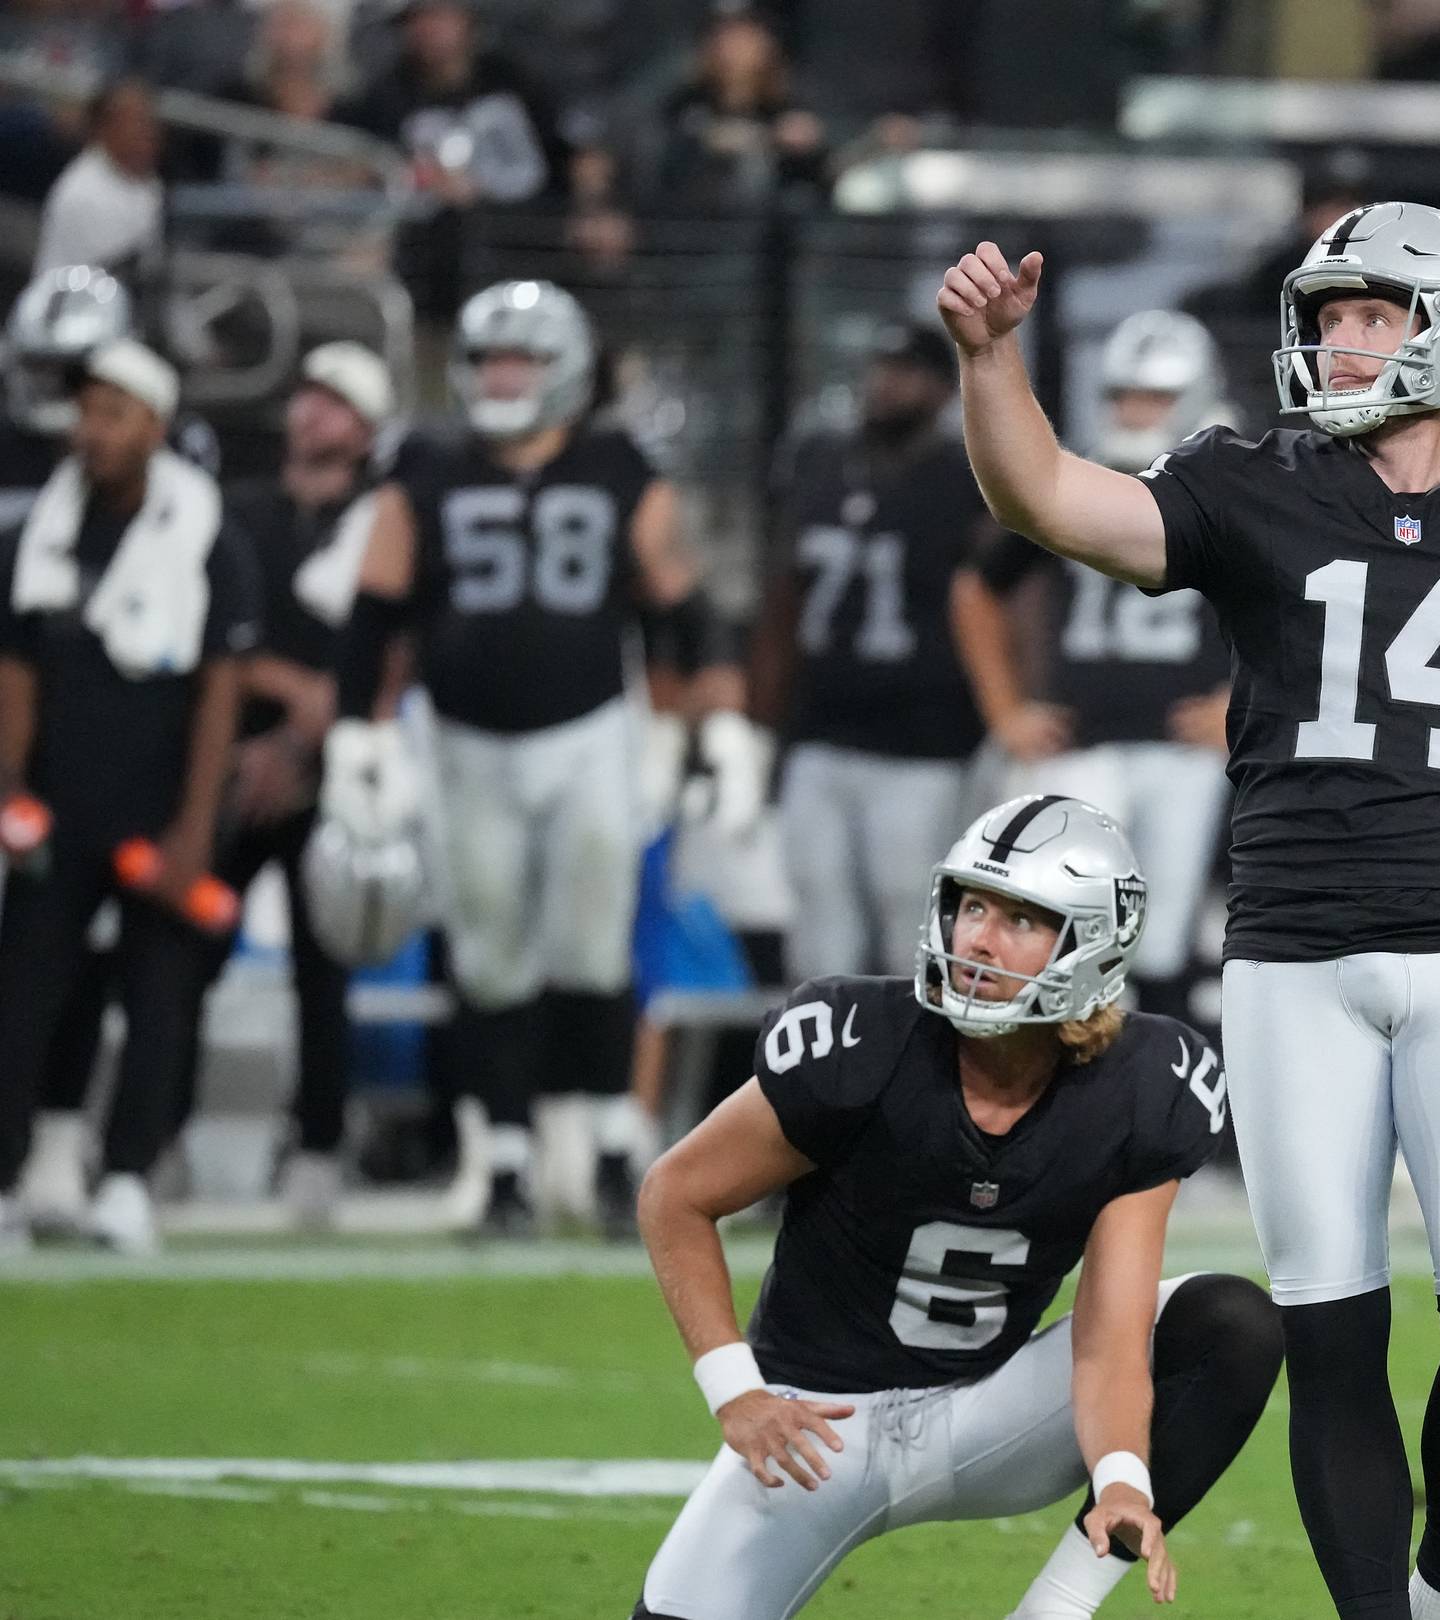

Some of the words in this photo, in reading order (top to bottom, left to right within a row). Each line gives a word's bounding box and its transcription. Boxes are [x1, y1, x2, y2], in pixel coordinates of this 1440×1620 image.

[442, 484, 617, 614] 58
[797, 526, 918, 659] 71
[1399, 527, 1418, 539] NFL
[764, 1000, 835, 1076] 6
[888, 1220, 1032, 1351] 6
